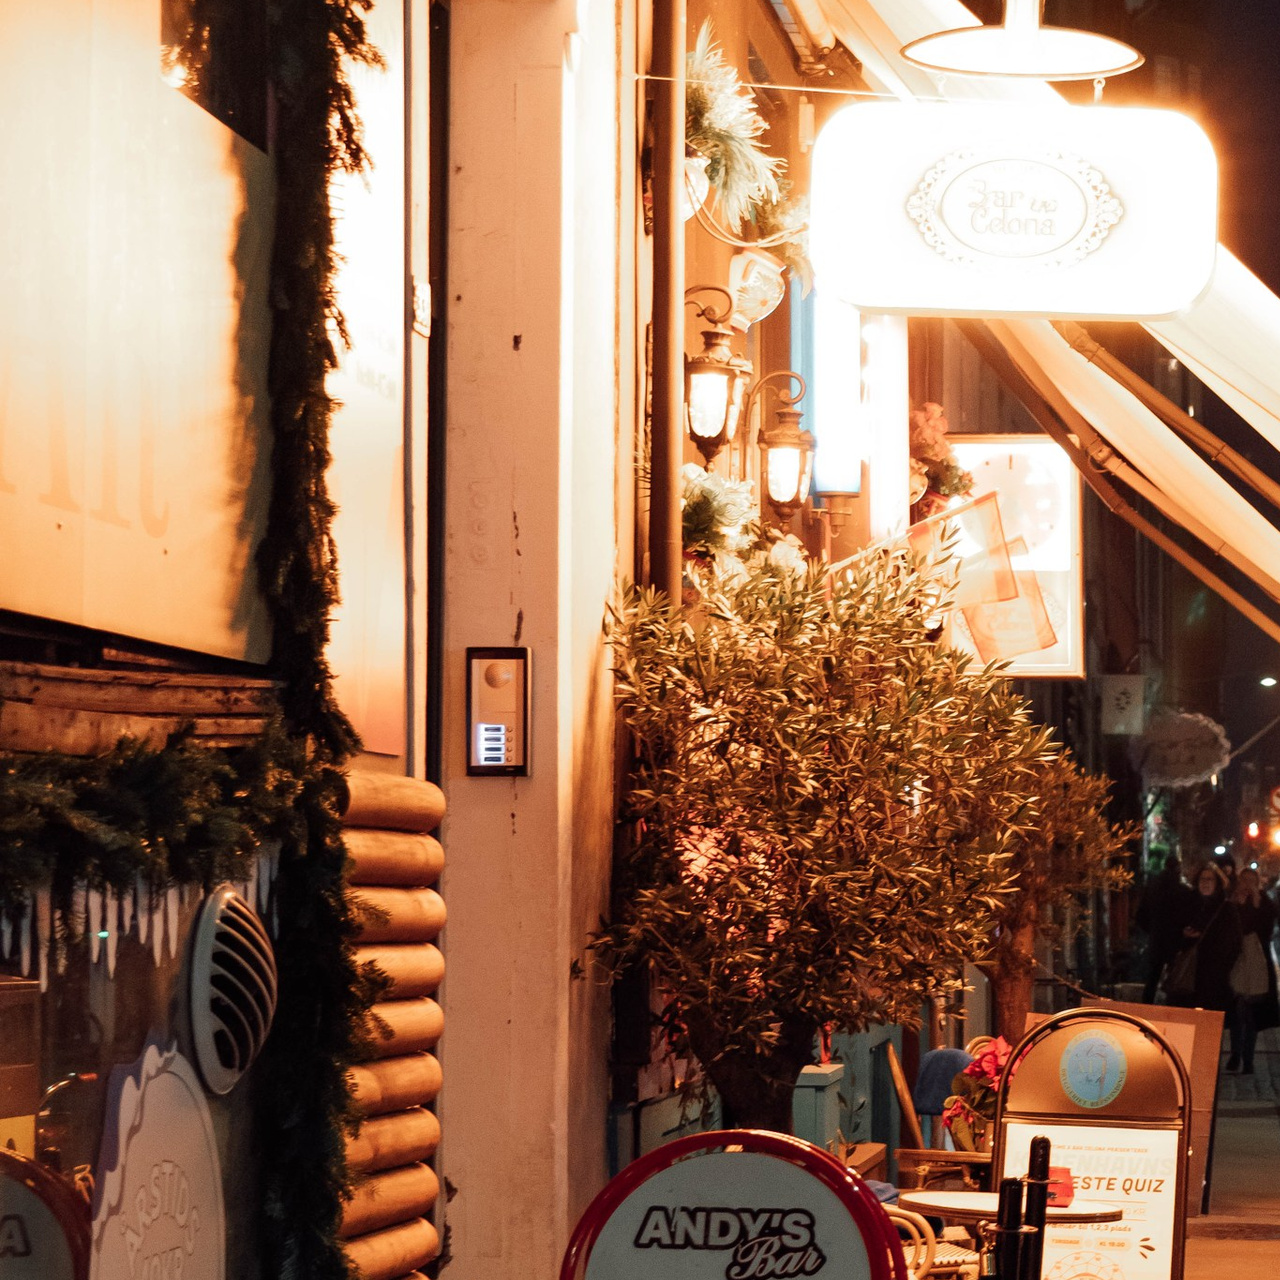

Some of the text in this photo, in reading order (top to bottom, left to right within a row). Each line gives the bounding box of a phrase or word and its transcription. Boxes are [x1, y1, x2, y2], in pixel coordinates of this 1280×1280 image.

[1122, 1177, 1165, 1195] QUIZ
[637, 1208, 814, 1248] ANDY'S
[728, 1235, 824, 1280] Bar
